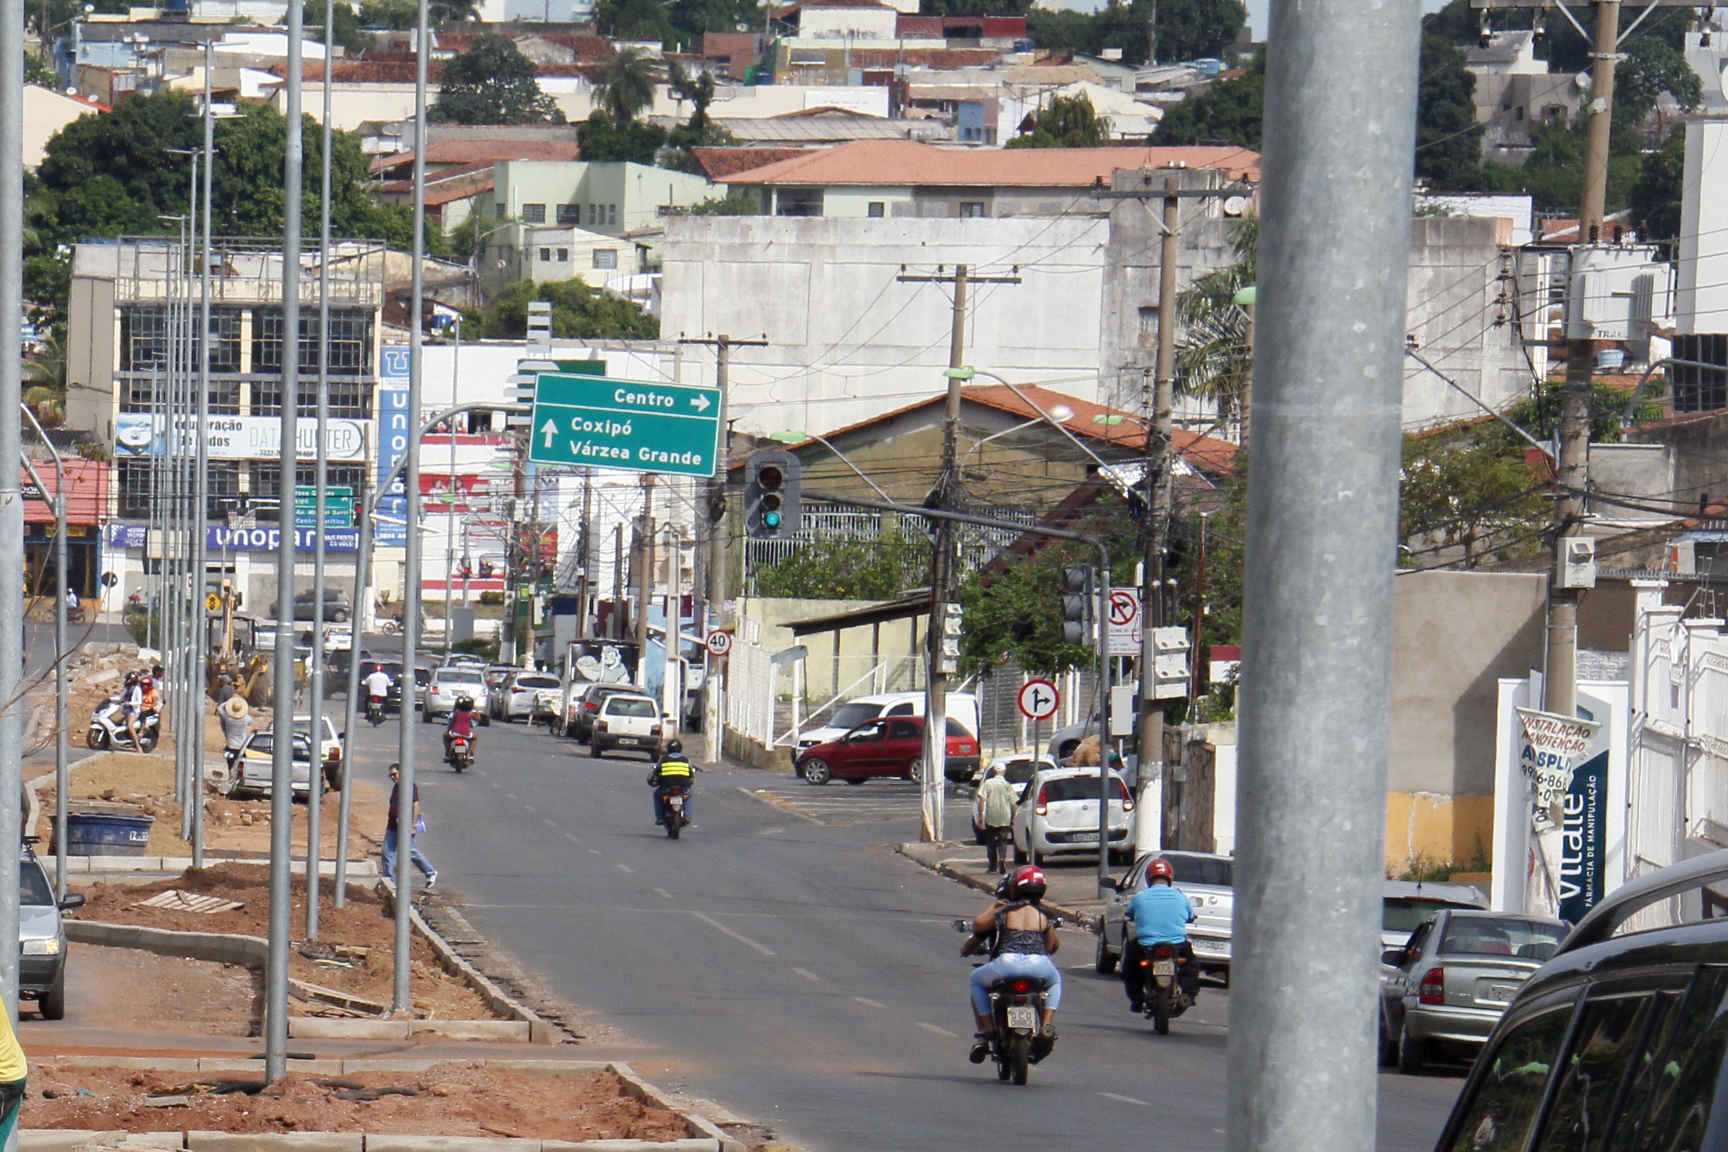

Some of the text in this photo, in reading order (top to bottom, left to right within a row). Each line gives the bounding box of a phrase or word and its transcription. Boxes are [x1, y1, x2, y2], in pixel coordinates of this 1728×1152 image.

[614, 388, 674, 407] Centro
[571, 417, 632, 437] Coxipó
[569, 440, 702, 466] Várzea Grande
[709, 634, 726, 647] 40
[1523, 716, 1591, 739] INSTALAÇÃO
[1585, 774, 1598, 843] MANIPULAÇÃO
